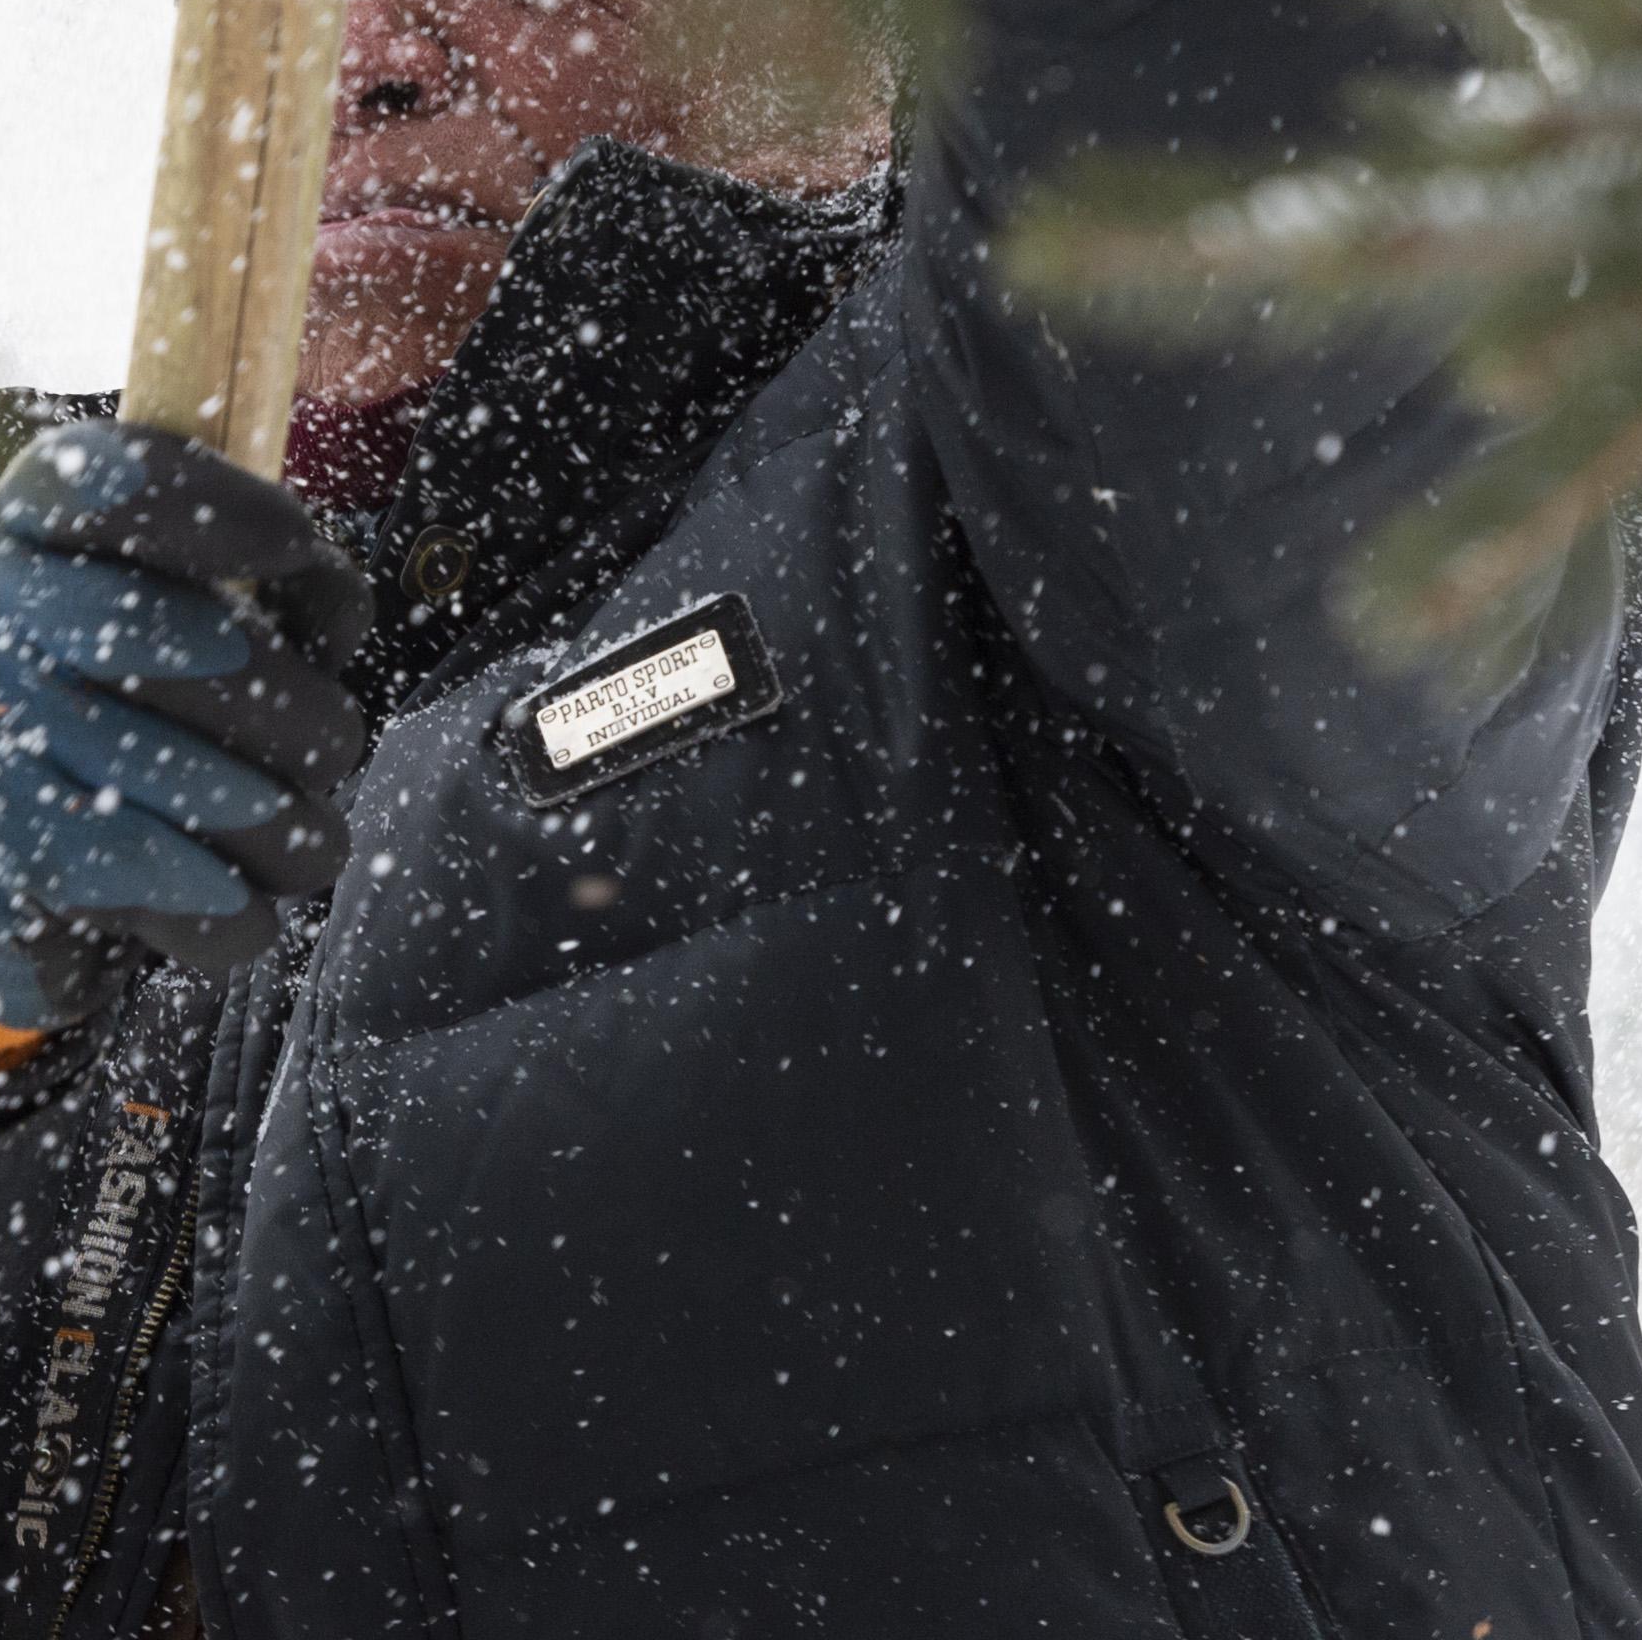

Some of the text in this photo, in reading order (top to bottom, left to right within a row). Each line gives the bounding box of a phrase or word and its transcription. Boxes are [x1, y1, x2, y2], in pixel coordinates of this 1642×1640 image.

[559, 643, 700, 724] PARTO SPORT
[586, 687, 697, 748] INDIVIDUAL
[62, 1101, 171, 1320] FASHION
